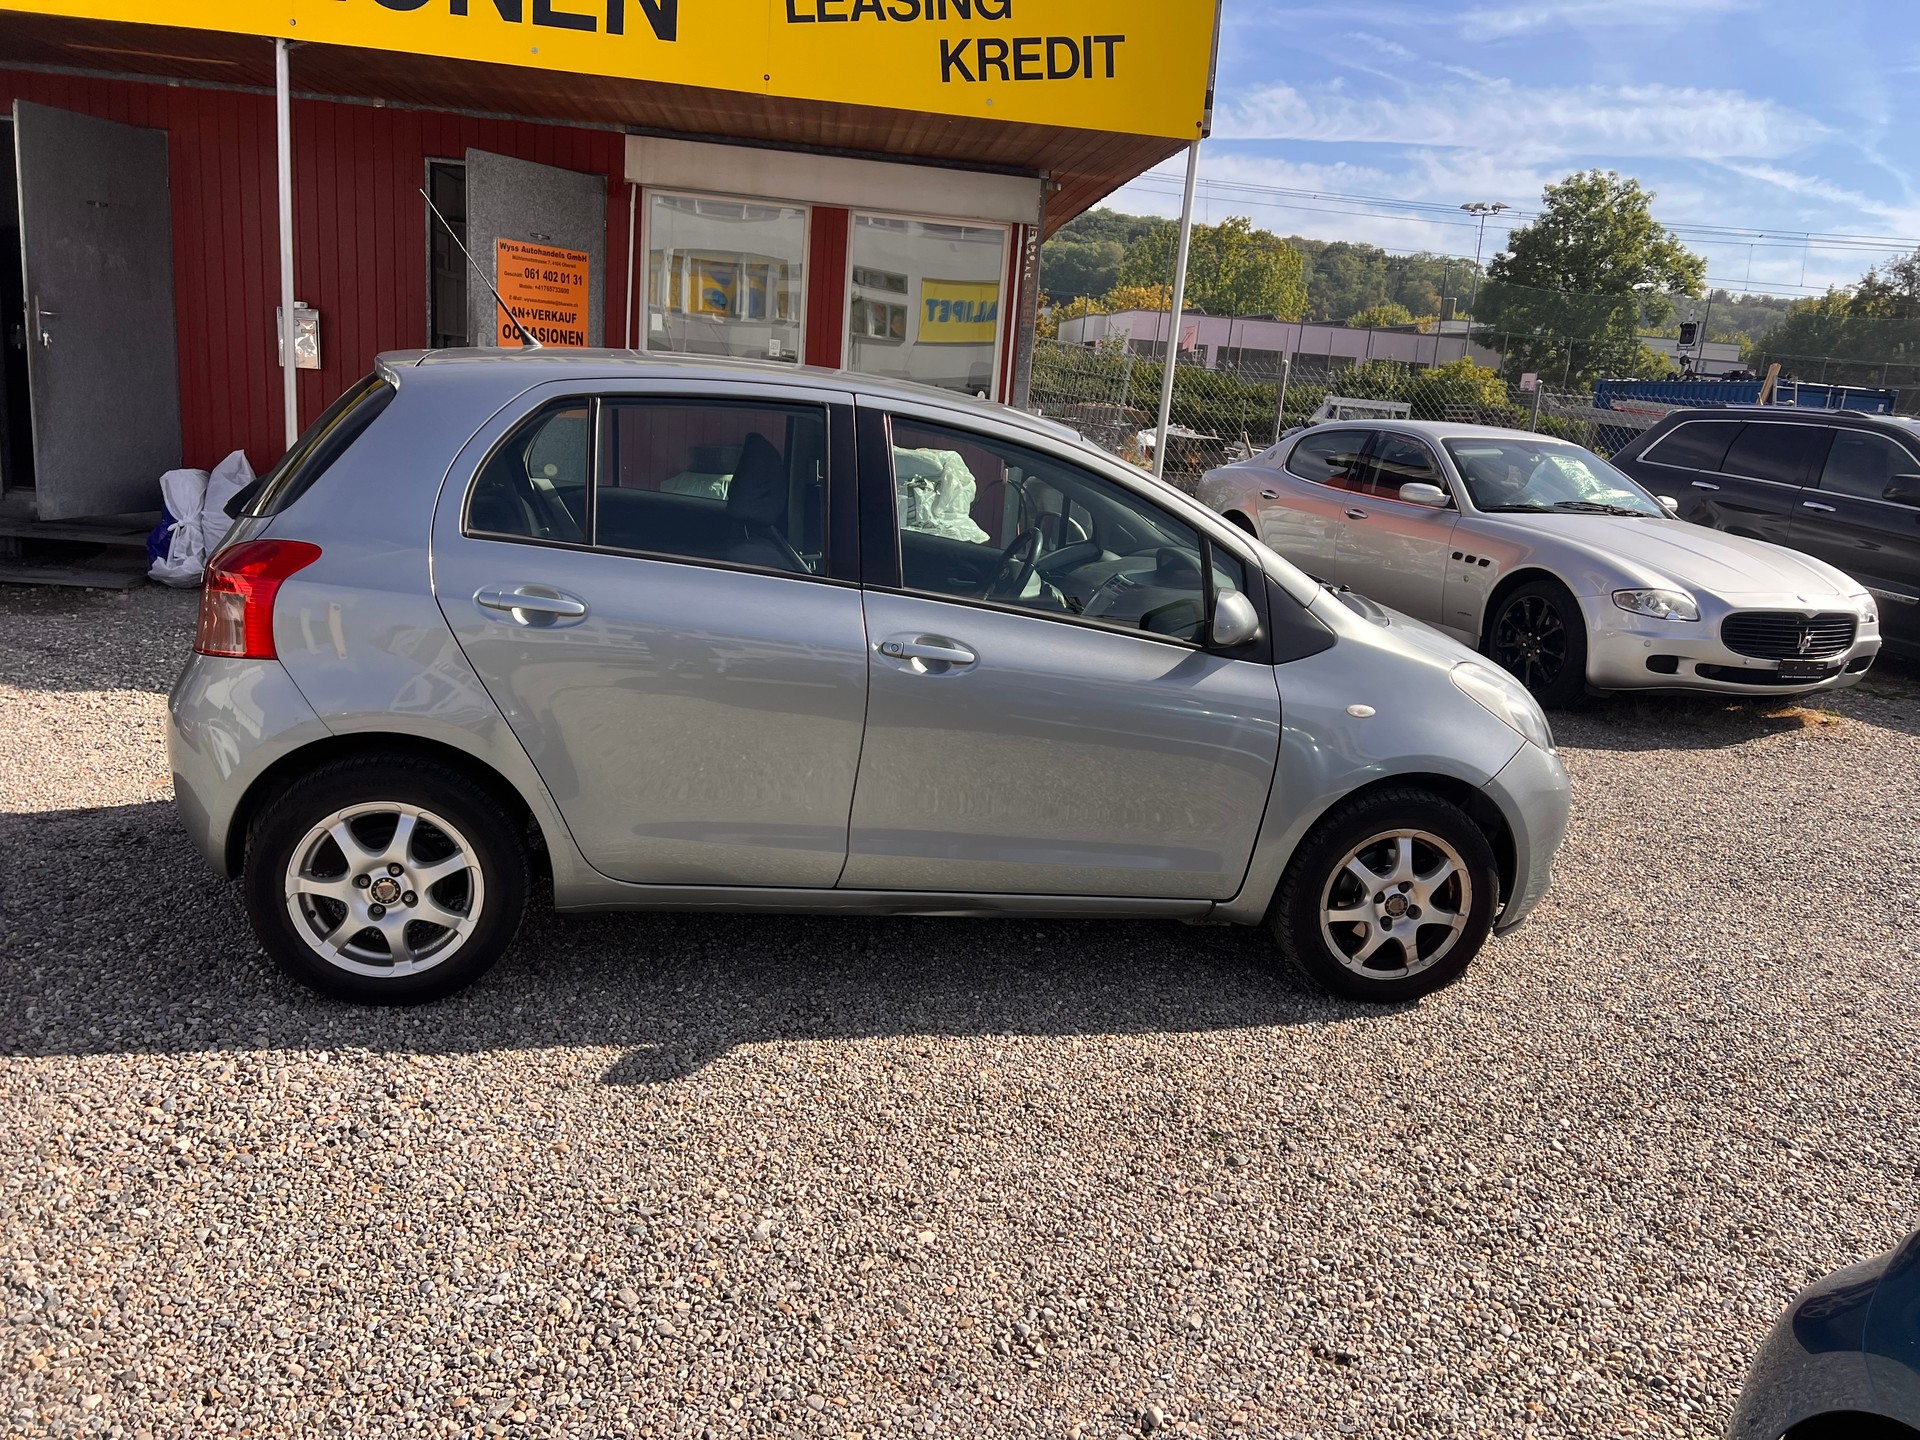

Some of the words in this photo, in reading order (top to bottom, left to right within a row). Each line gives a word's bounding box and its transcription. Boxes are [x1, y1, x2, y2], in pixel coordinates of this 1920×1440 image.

[940, 35, 1125, 83] KREDIT
[500, 242, 519, 252] Wyss
[521, 246, 565, 259] Autohandels
[566, 253, 587, 263] GmbH
[525, 268, 540, 280] 061
[543, 271, 558, 283] 402
[561, 273, 570, 284] 01
[573, 275, 582, 286] 31
[511, 306, 577, 323] AN+VERKAUF
